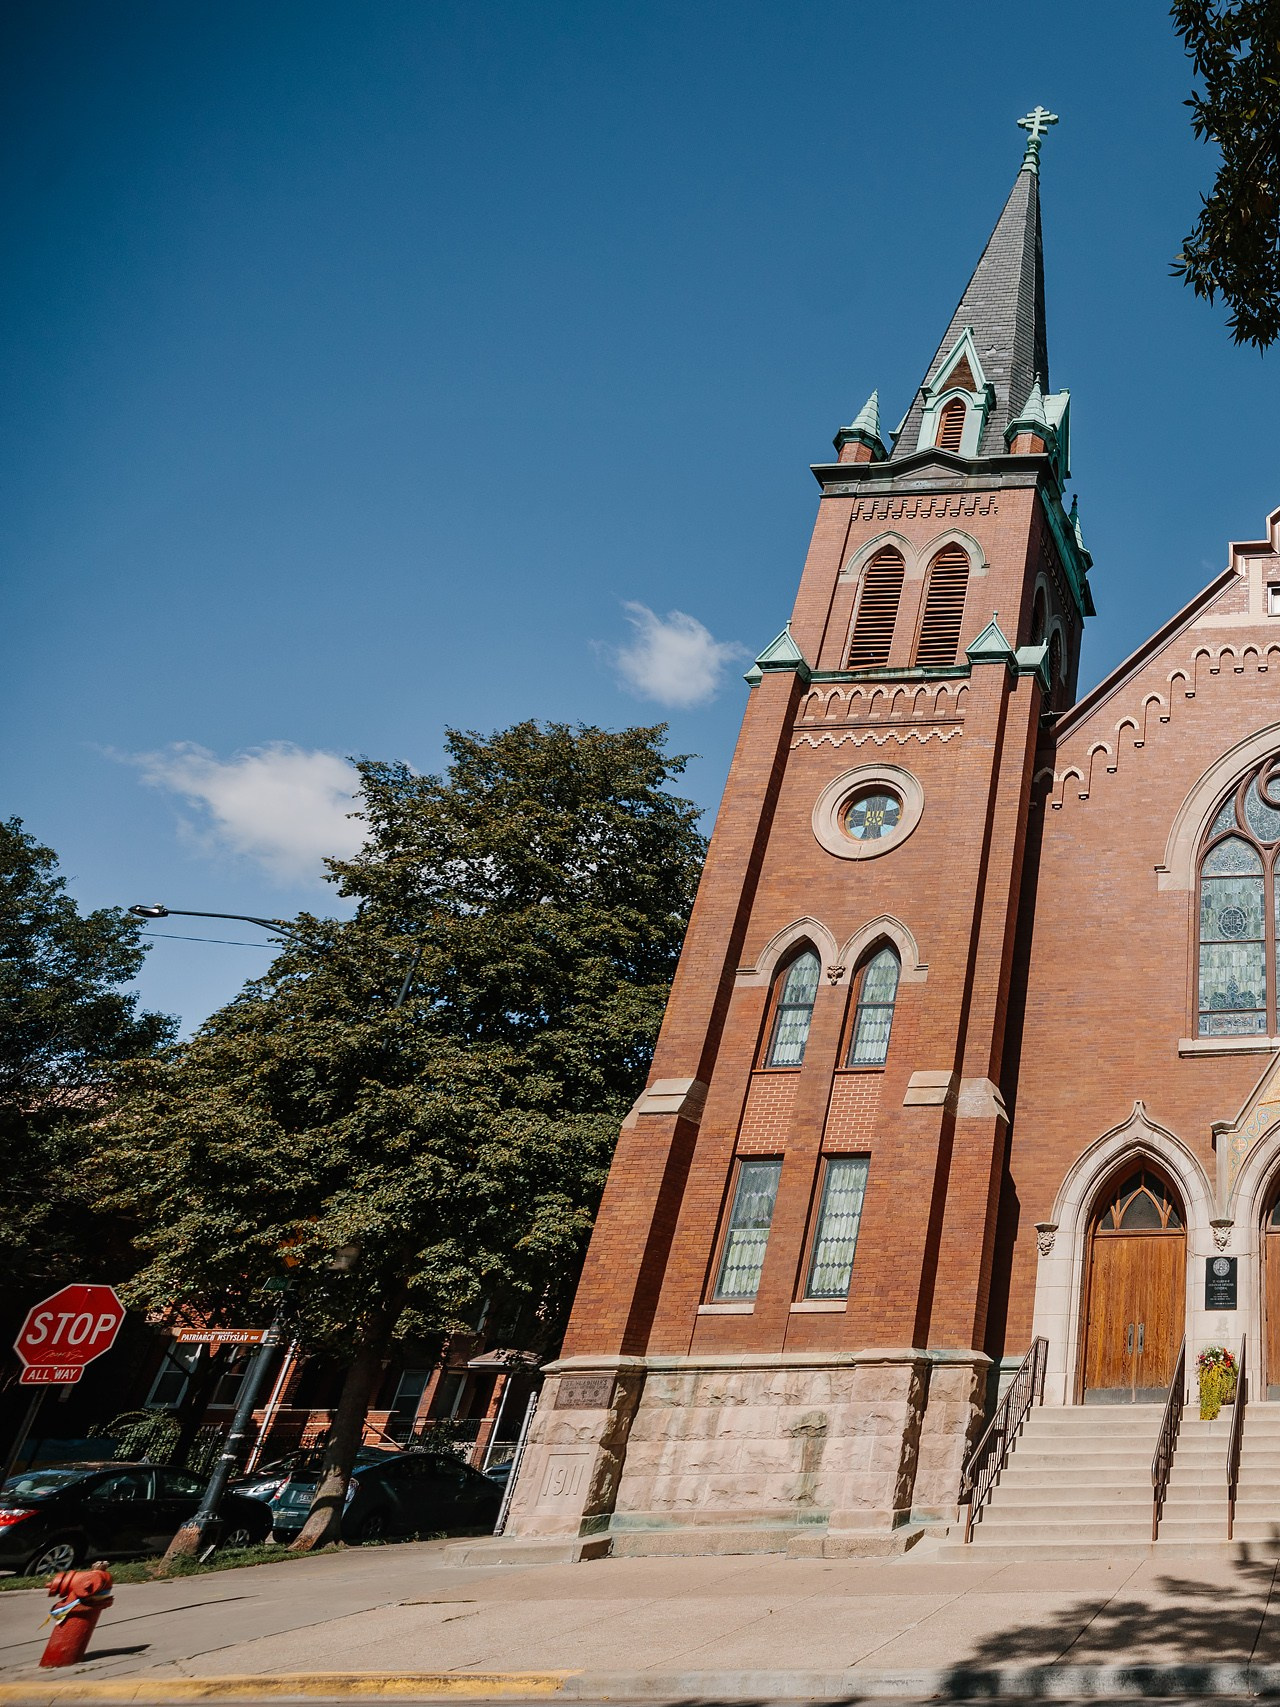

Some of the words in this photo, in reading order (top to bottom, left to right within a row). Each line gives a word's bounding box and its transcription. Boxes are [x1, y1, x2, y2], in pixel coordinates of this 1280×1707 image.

[26, 1312, 117, 1345] STOP
[181, 1333, 215, 1341] PATRIARCH
[217, 1333, 249, 1341] MSTYSLAV
[27, 1369, 49, 1380] ALL
[54, 1369, 78, 1380] WAY
[543, 1465, 584, 1497] 1911
